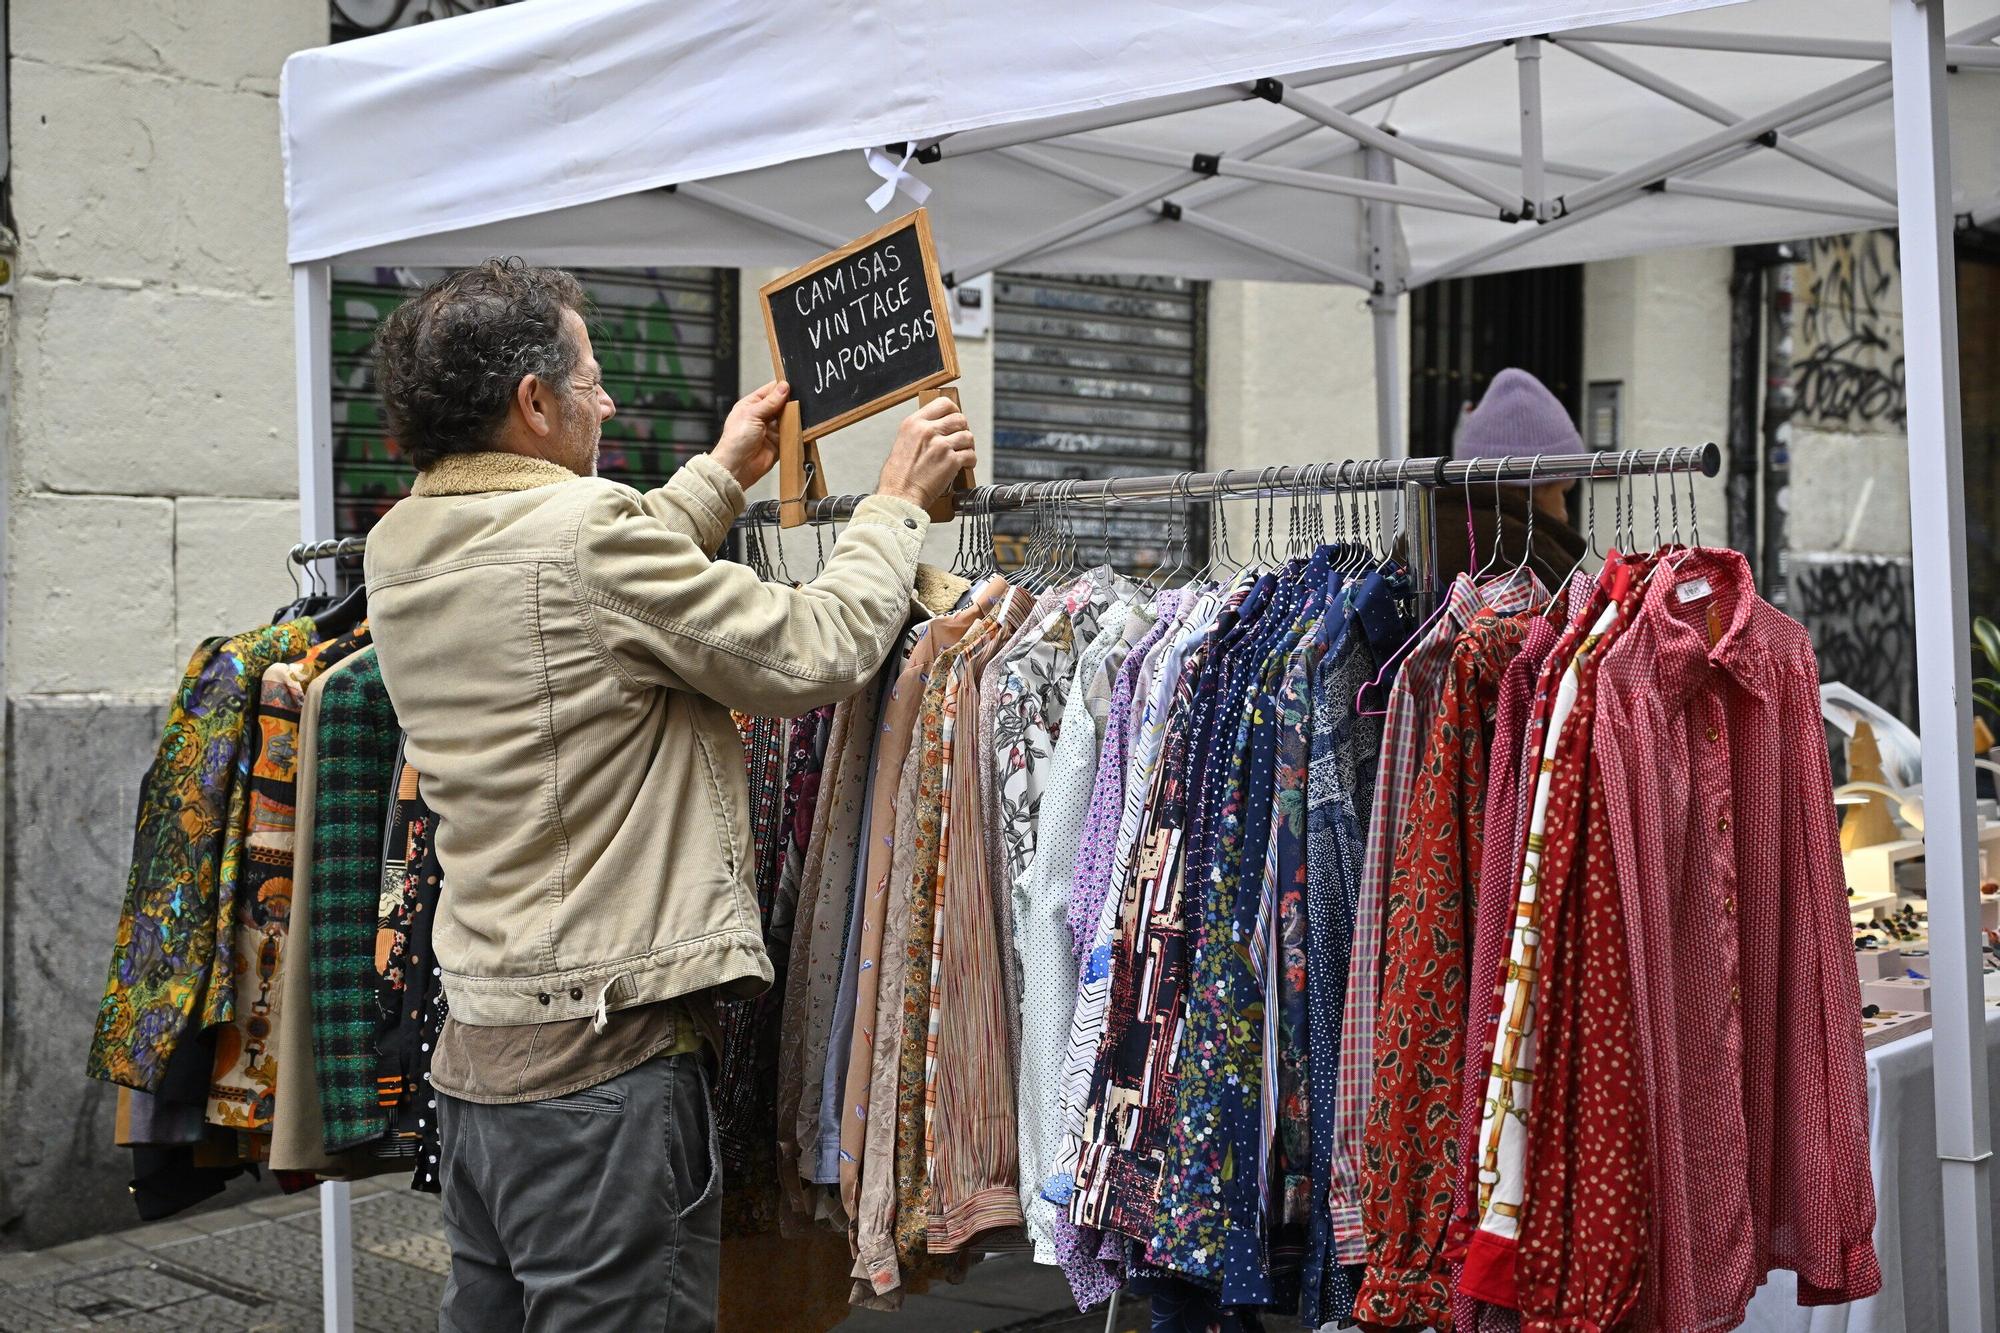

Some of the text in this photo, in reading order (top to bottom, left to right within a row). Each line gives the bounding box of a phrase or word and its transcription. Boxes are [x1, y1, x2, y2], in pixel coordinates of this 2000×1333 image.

[795, 245, 901, 316] CAMISAS
[808, 277, 912, 350] VINTAGE
[814, 309, 936, 394] JAPONESAS
